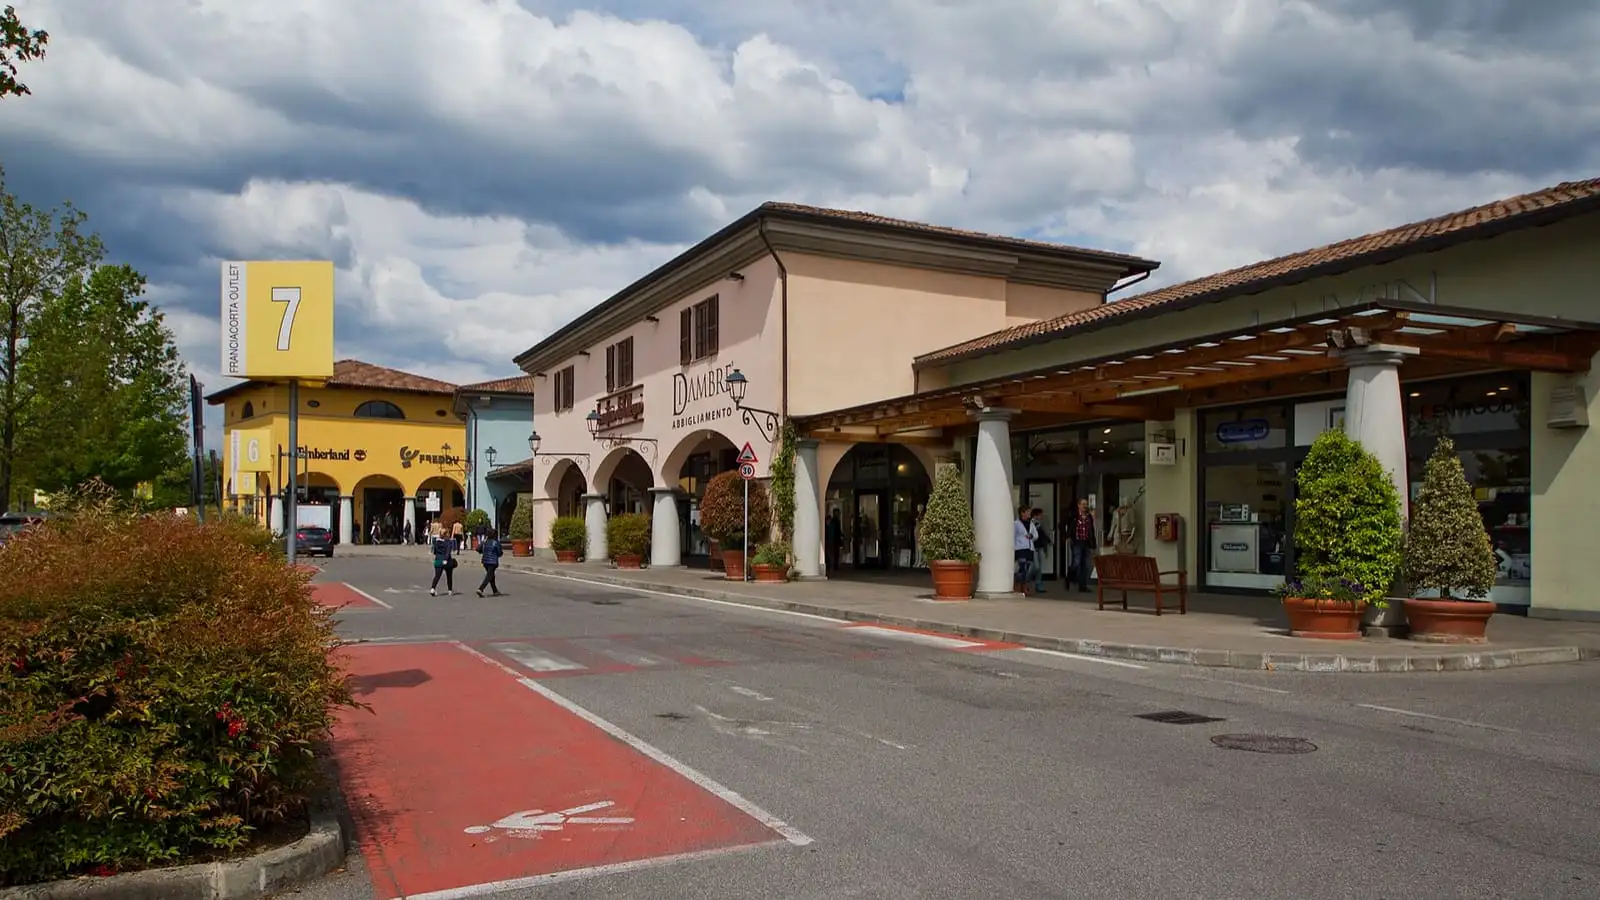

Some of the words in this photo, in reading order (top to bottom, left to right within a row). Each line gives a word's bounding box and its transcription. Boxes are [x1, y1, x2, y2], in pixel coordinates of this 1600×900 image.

[229, 264, 239, 300] OUTLET
[271, 286, 302, 351] 7
[229, 302, 239, 374] FRANCIACORTA
[672, 406, 732, 430] ABBIGLIAMENTO
[247, 438, 260, 463] 6
[742, 466, 752, 475] 30
